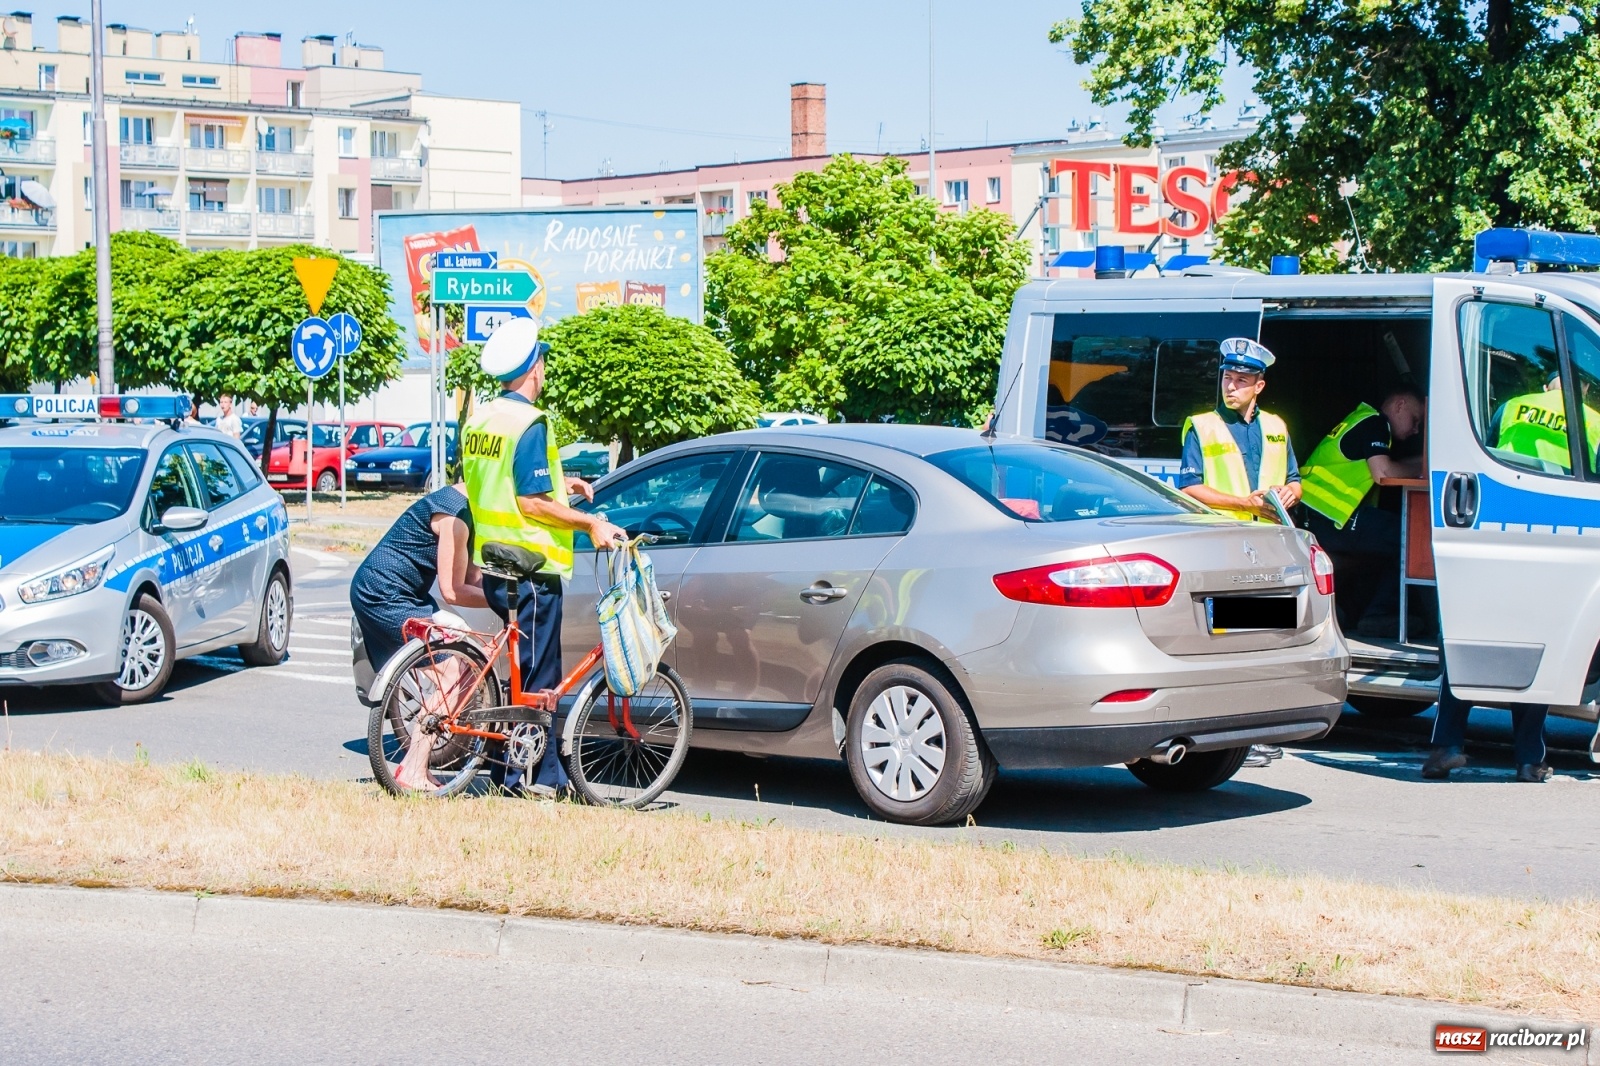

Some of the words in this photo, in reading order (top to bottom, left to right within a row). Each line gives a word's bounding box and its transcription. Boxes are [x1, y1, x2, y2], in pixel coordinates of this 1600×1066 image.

[1050, 158, 1318, 239] TESC
[544, 219, 642, 252] RADOSNE
[444, 256, 454, 267] ul.
[455, 256, 482, 269] Łąkowa
[583, 245, 677, 274] PORANKI
[447, 277, 514, 299] Rybnik
[485, 315, 494, 329] 4
[35, 398, 96, 413] POLICJA
[171, 542, 205, 575] POLICJA
[1231, 573, 1283, 585] FLUENCE
